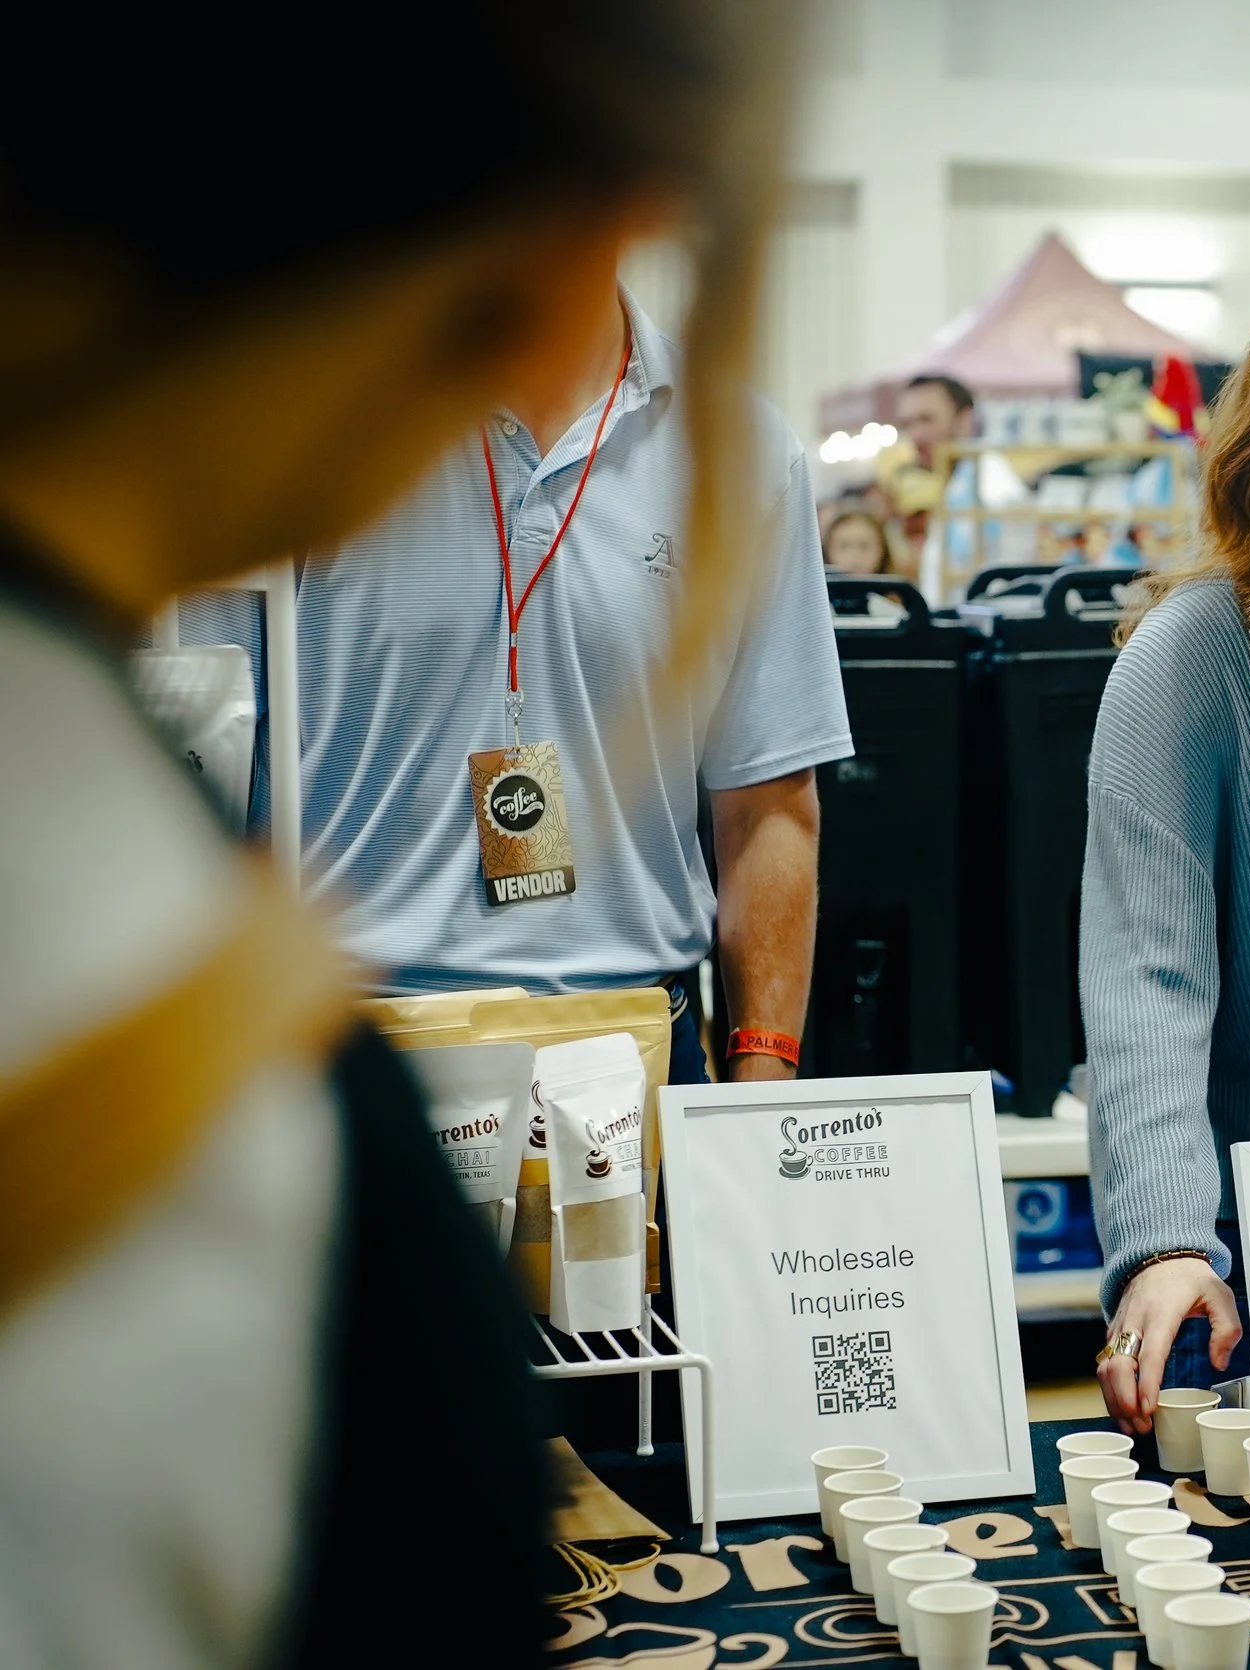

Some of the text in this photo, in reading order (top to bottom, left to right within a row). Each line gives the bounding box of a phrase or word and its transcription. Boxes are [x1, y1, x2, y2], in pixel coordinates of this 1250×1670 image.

[494, 869, 567, 902] VENDOR
[747, 1036, 793, 1053] PALMER
[781, 1107, 883, 1156] Sorrento's
[814, 1145, 888, 1163] COFFEE
[474, 1170, 491, 1178] TEXAS
[815, 1166, 890, 1181] DRIVE THRU
[771, 1245, 914, 1275] Wholesale
[791, 1287, 905, 1319] Inquiries
